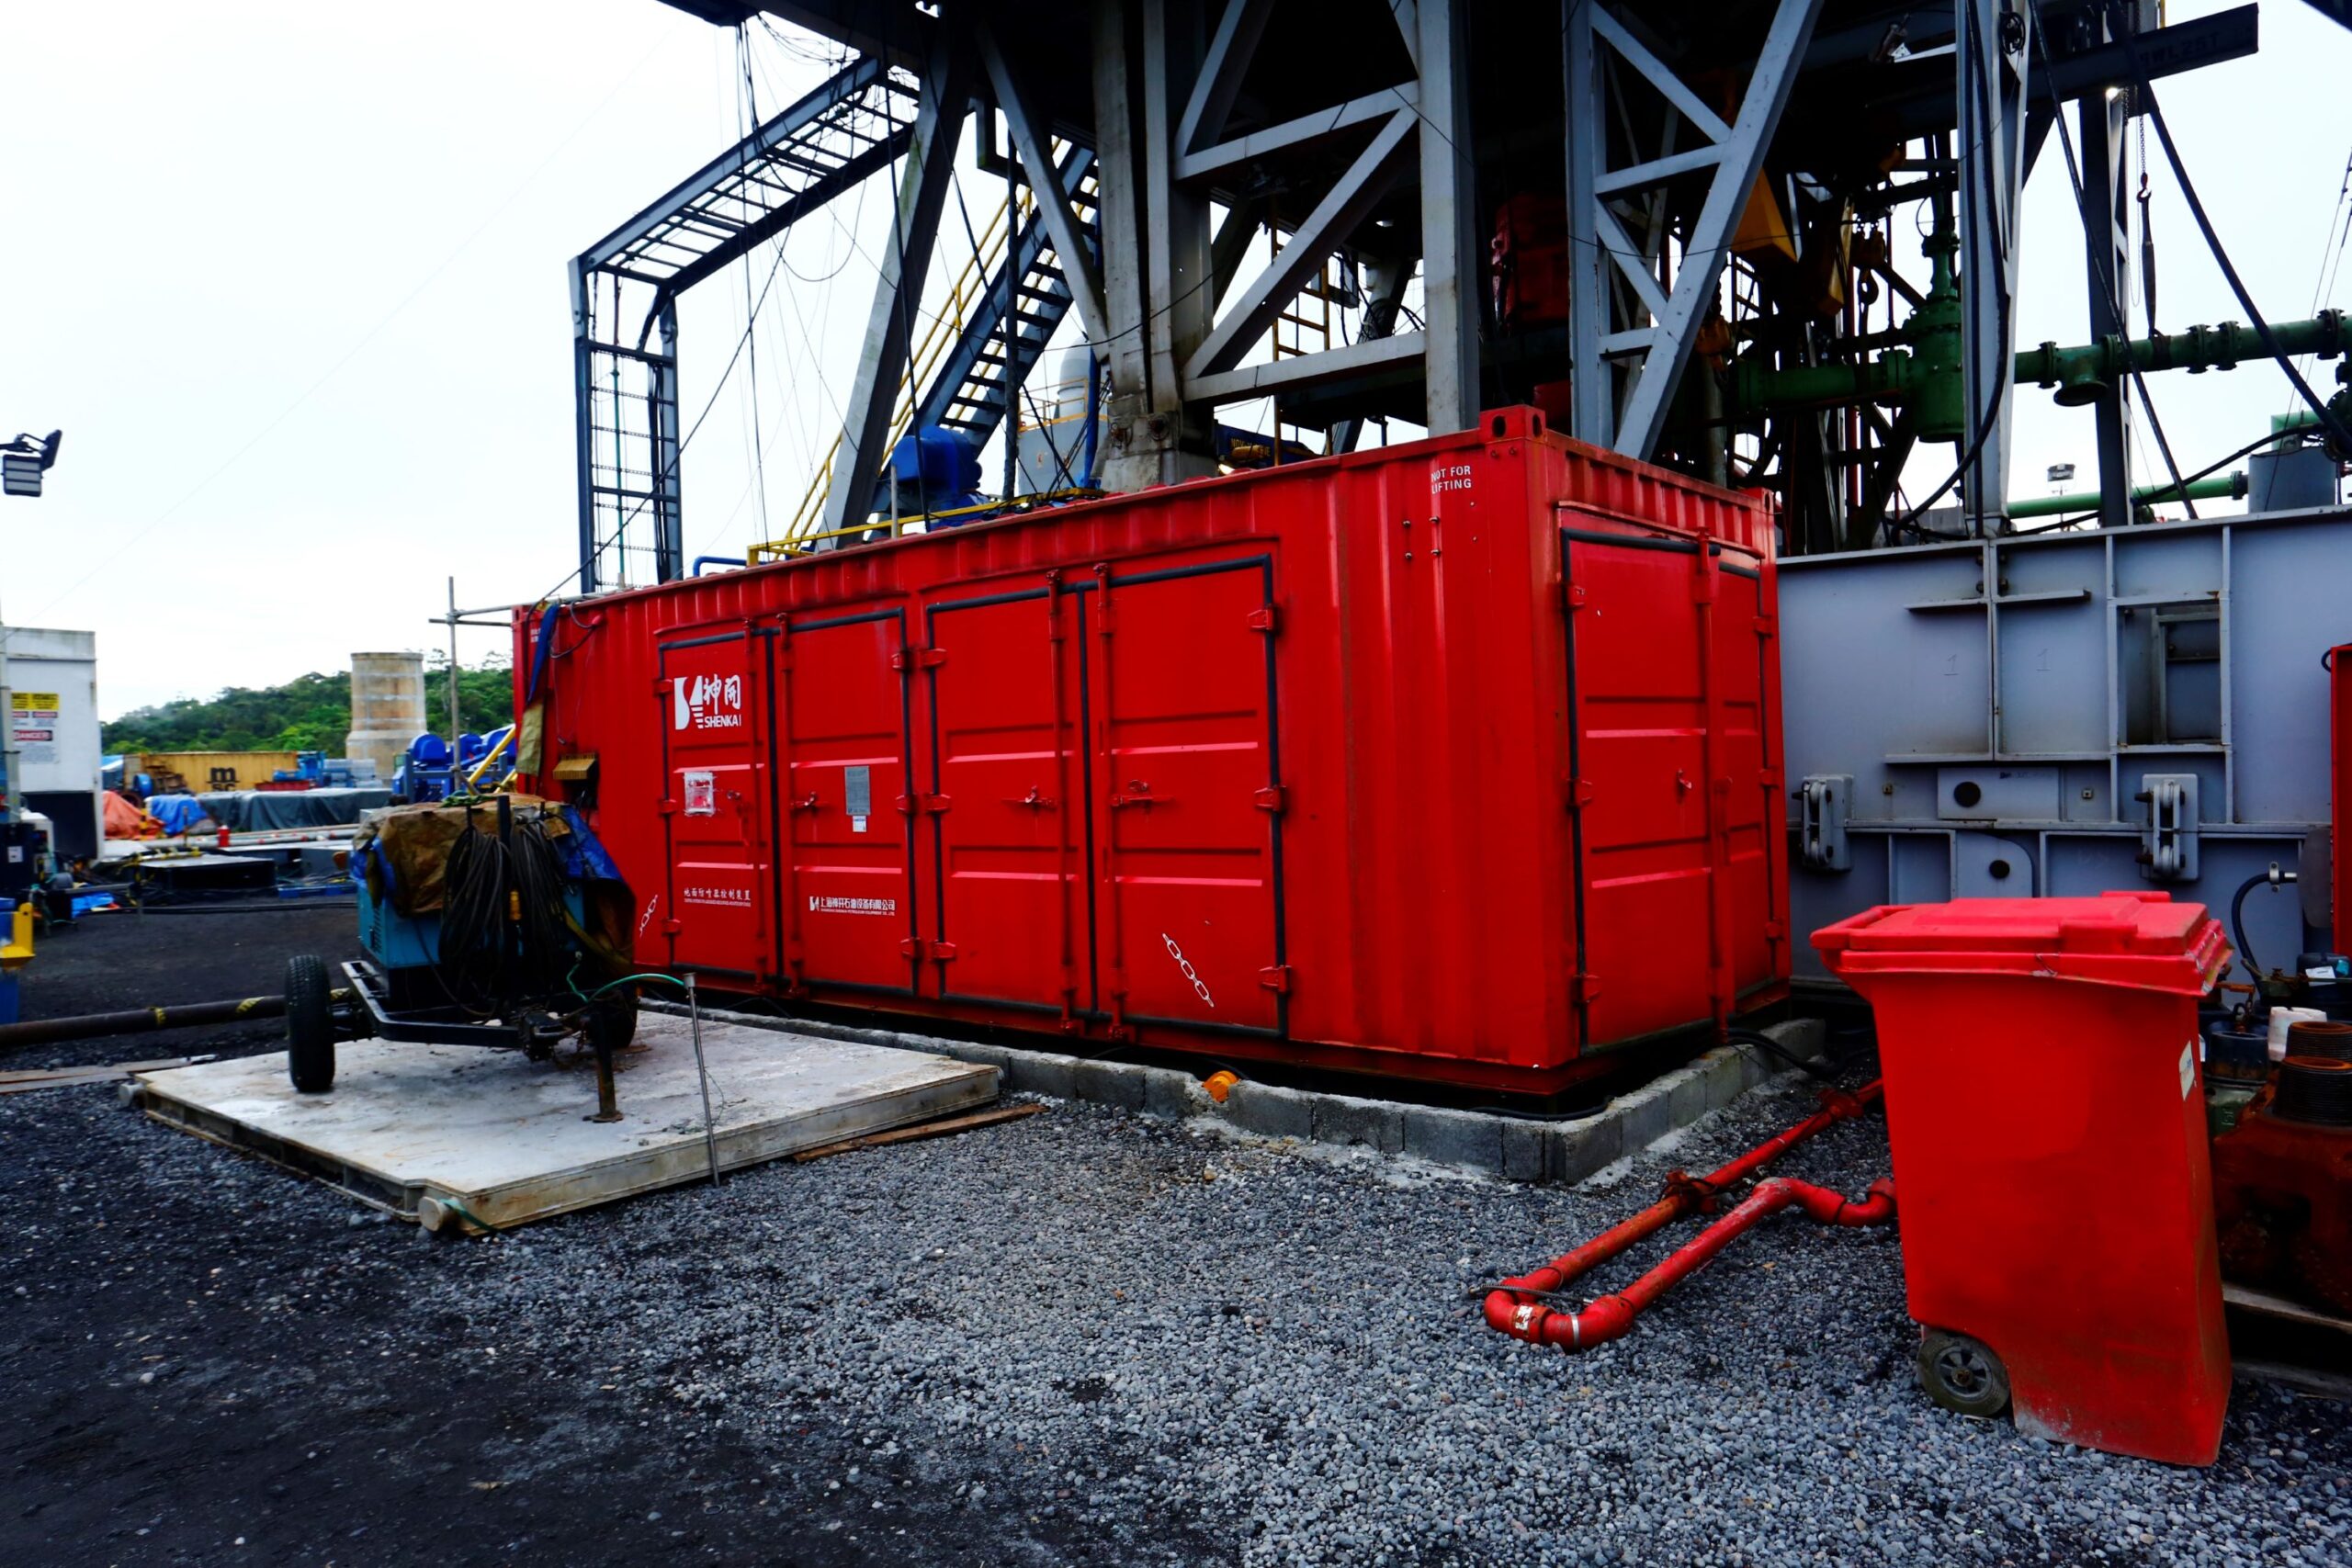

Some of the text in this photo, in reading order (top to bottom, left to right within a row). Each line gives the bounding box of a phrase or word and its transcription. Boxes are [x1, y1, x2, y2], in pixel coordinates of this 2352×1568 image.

[1430, 465, 1471, 483] NOT FOR
[1431, 479, 1472, 495] LIFTING
[704, 714, 742, 728] SHENKAI
